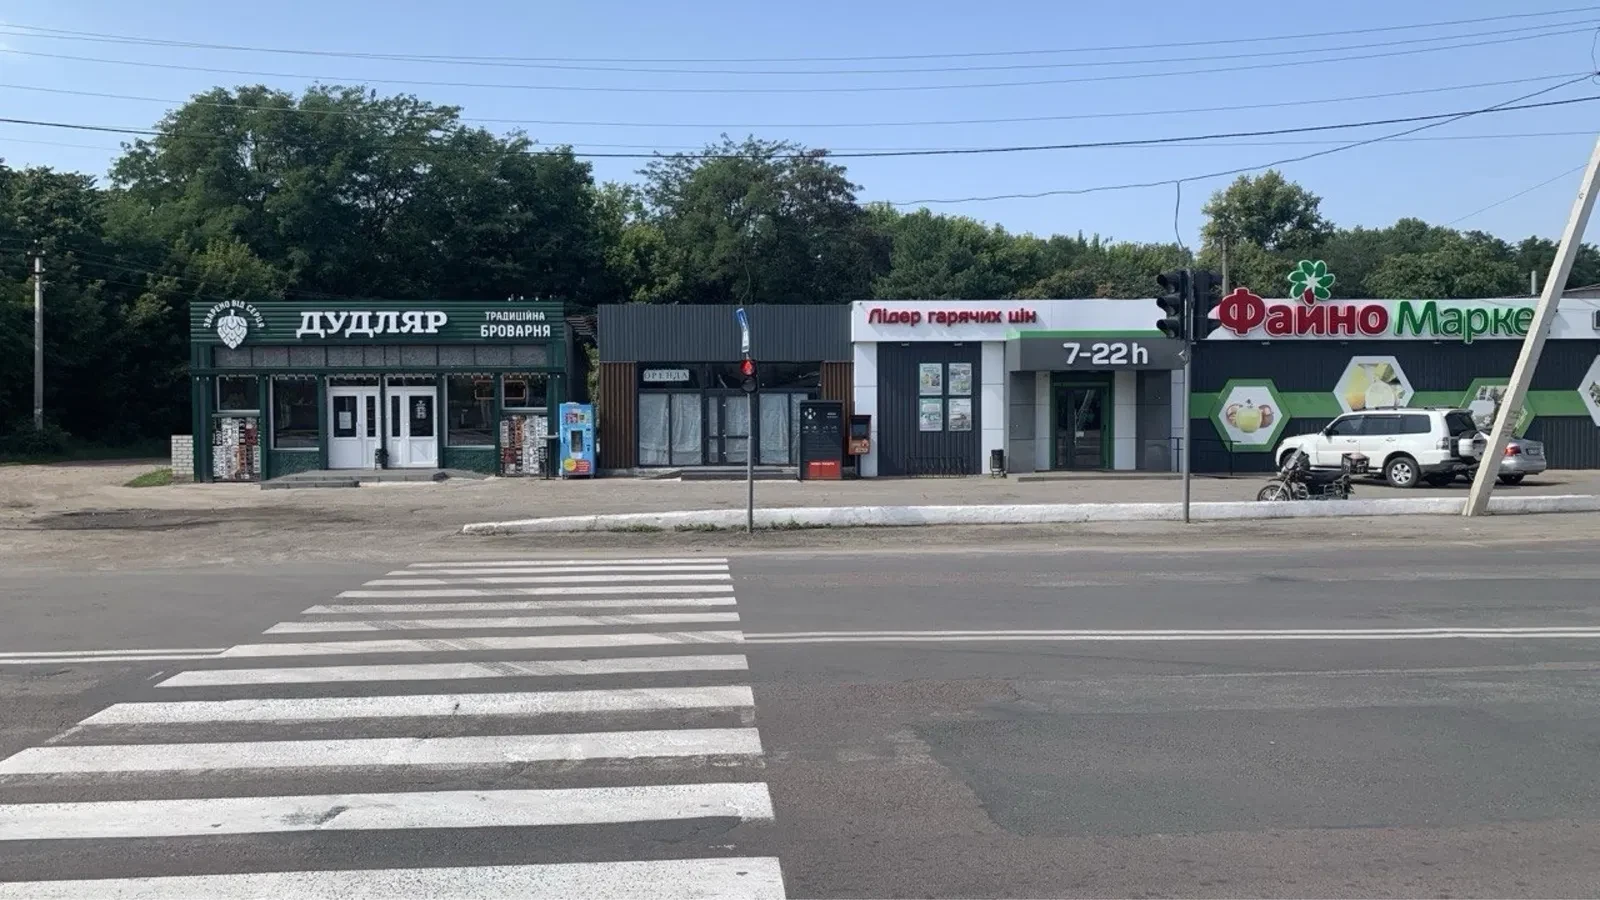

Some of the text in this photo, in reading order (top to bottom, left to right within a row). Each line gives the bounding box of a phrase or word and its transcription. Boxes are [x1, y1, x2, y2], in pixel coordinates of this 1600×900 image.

[203, 299, 265, 328] ЗВАРЕНО ВІД СЕРЦЯ
[485, 310, 546, 321] ТРАДИЦІЙНА
[868, 308, 1037, 326] Лідер гарячих цін
[1218, 287, 1389, 336] Файно
[1394, 300, 1537, 344] Марке
[296, 311, 448, 338] ДУДЛЯР
[480, 324, 551, 337] БРОВАРНЯ
[643, 370, 689, 381] ОРЕНДА
